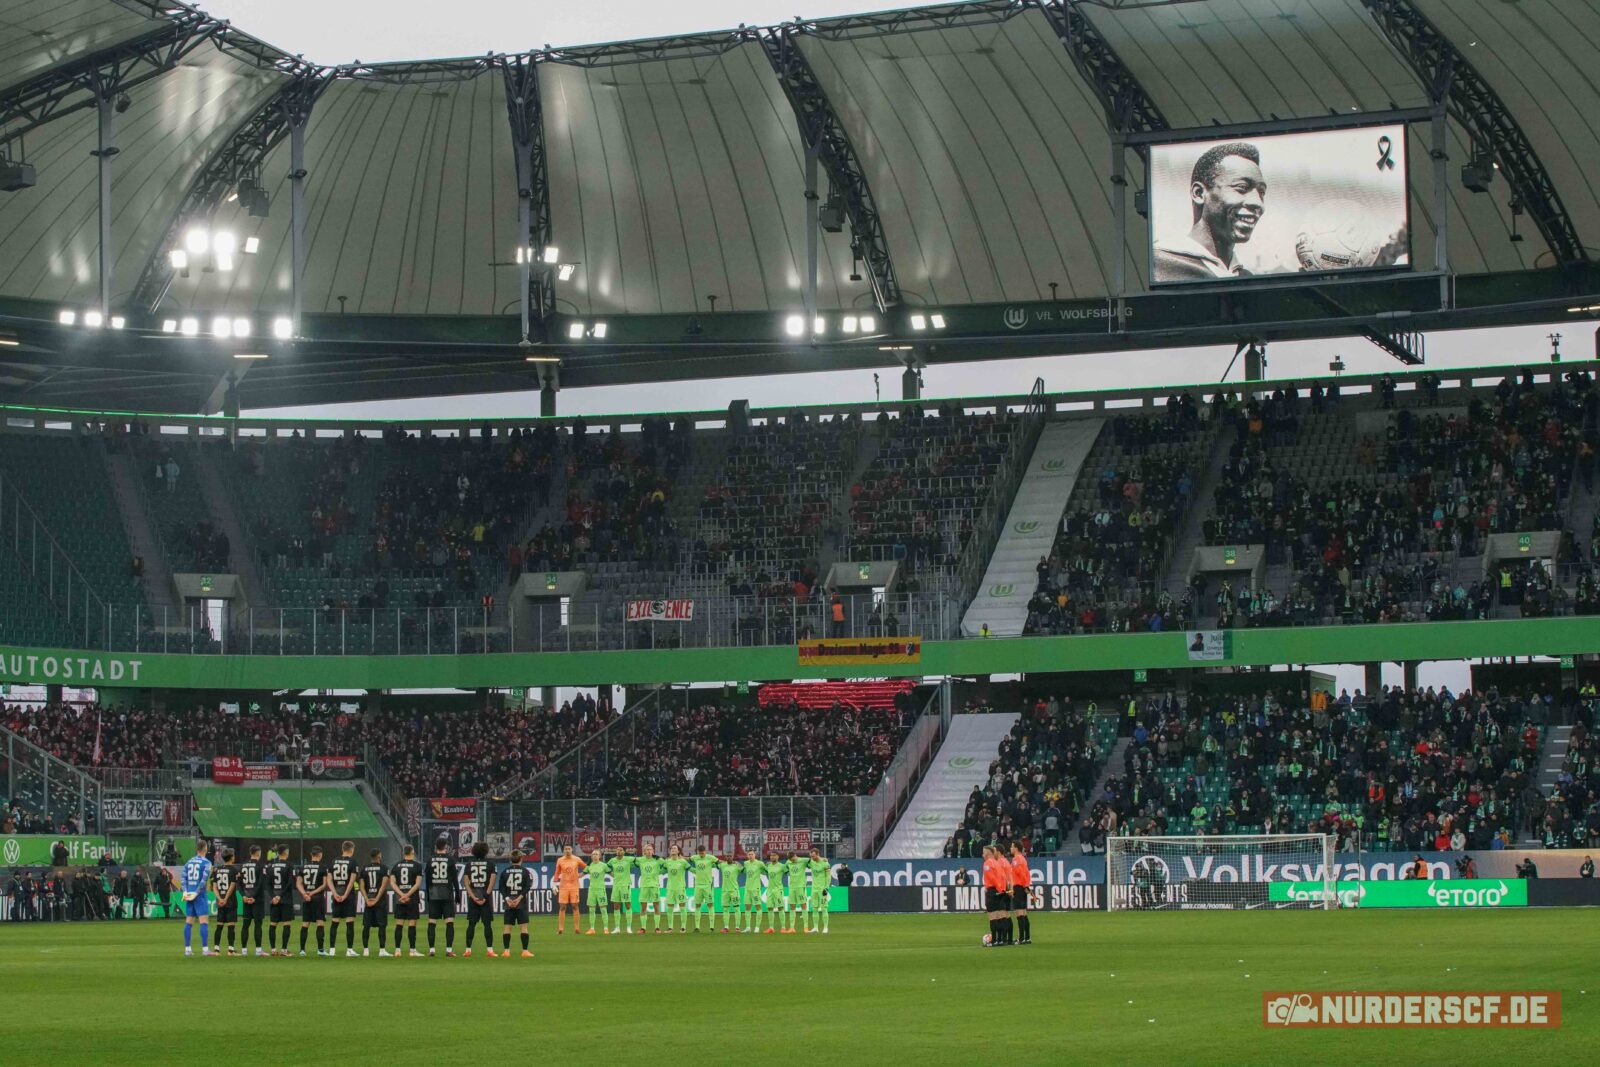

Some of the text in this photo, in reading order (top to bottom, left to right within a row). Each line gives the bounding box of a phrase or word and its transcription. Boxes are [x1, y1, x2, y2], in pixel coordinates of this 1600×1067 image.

[1036, 307, 1133, 321] VfL WOLFSBUG
[0, 654, 143, 681] AUTOSTADT
[187, 863, 200, 881] 26
[242, 867, 256, 884] 30
[273, 867, 282, 885] 5
[303, 869, 318, 886] 27
[333, 863, 348, 881] 28
[400, 867, 409, 885] 8
[431, 861, 448, 879] 38
[471, 865, 487, 883] 25
[217, 873, 230, 890] 29
[506, 873, 523, 891] 42
[923, 886, 951, 910] DIE
[1051, 885, 1099, 909] SOCIAL
